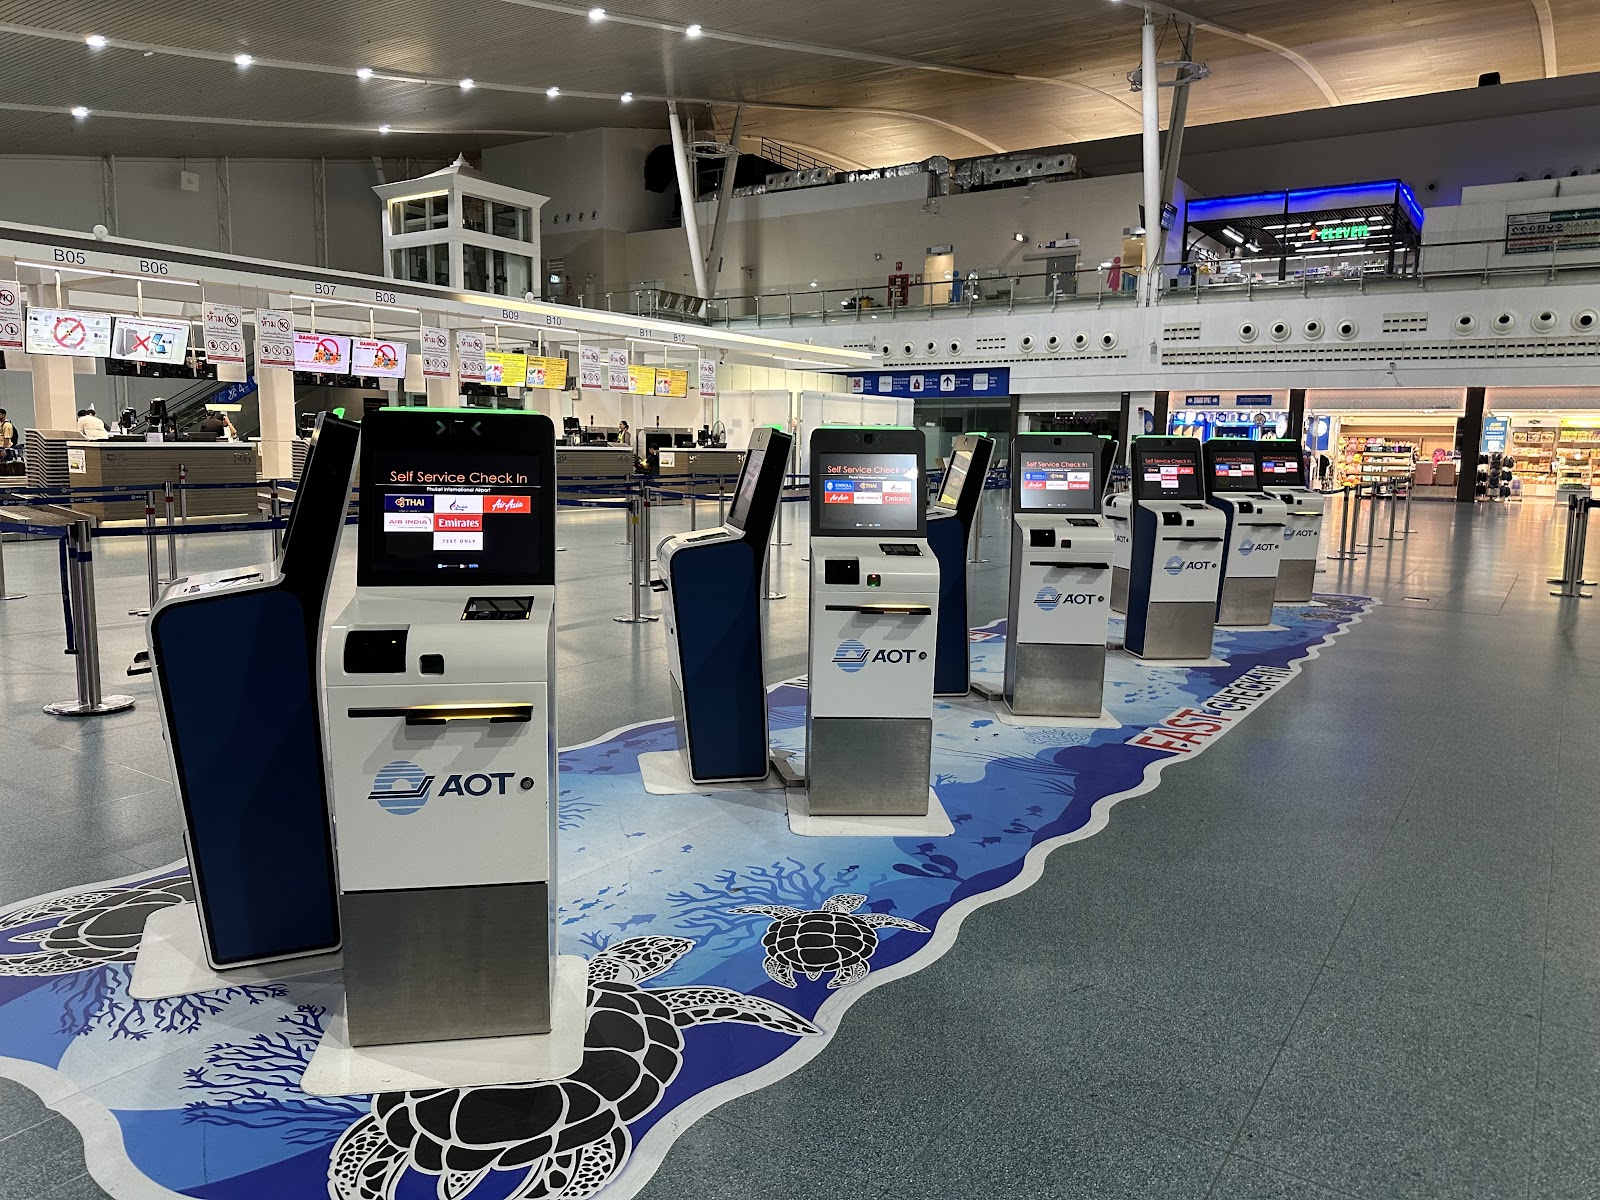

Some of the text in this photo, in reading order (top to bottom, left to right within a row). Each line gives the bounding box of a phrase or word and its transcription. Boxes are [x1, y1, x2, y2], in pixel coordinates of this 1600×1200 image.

[54, 248, 86, 265] B05
[140, 260, 169, 275] B06
[314, 283, 337, 296] B07
[375, 292, 396, 304] B08
[206, 310, 224, 323] ห้าม
[502, 309, 519, 321] B09
[546, 315, 562, 326] B10
[261, 316, 277, 328] ห้าม
[639, 328, 652, 338] B11
[673, 333, 686, 342] B12
[827, 465, 842, 474] Self
[843, 466, 872, 474] Service
[873, 465, 899, 474] Check
[390, 470, 528, 484] Self Service Check In
[405, 498, 425, 507] THAI
[438, 518, 480, 528] Emirates
[1116, 535, 1126, 543] AOT
[1254, 543, 1275, 551] AOT
[1185, 561, 1211, 570] AOT
[1063, 593, 1097, 605] AOT
[871, 649, 917, 664] AOT
[1206, 665, 1295, 712] CHECK-IN
[1135, 708, 1233, 753] FAST
[437, 772, 517, 797] AOT
